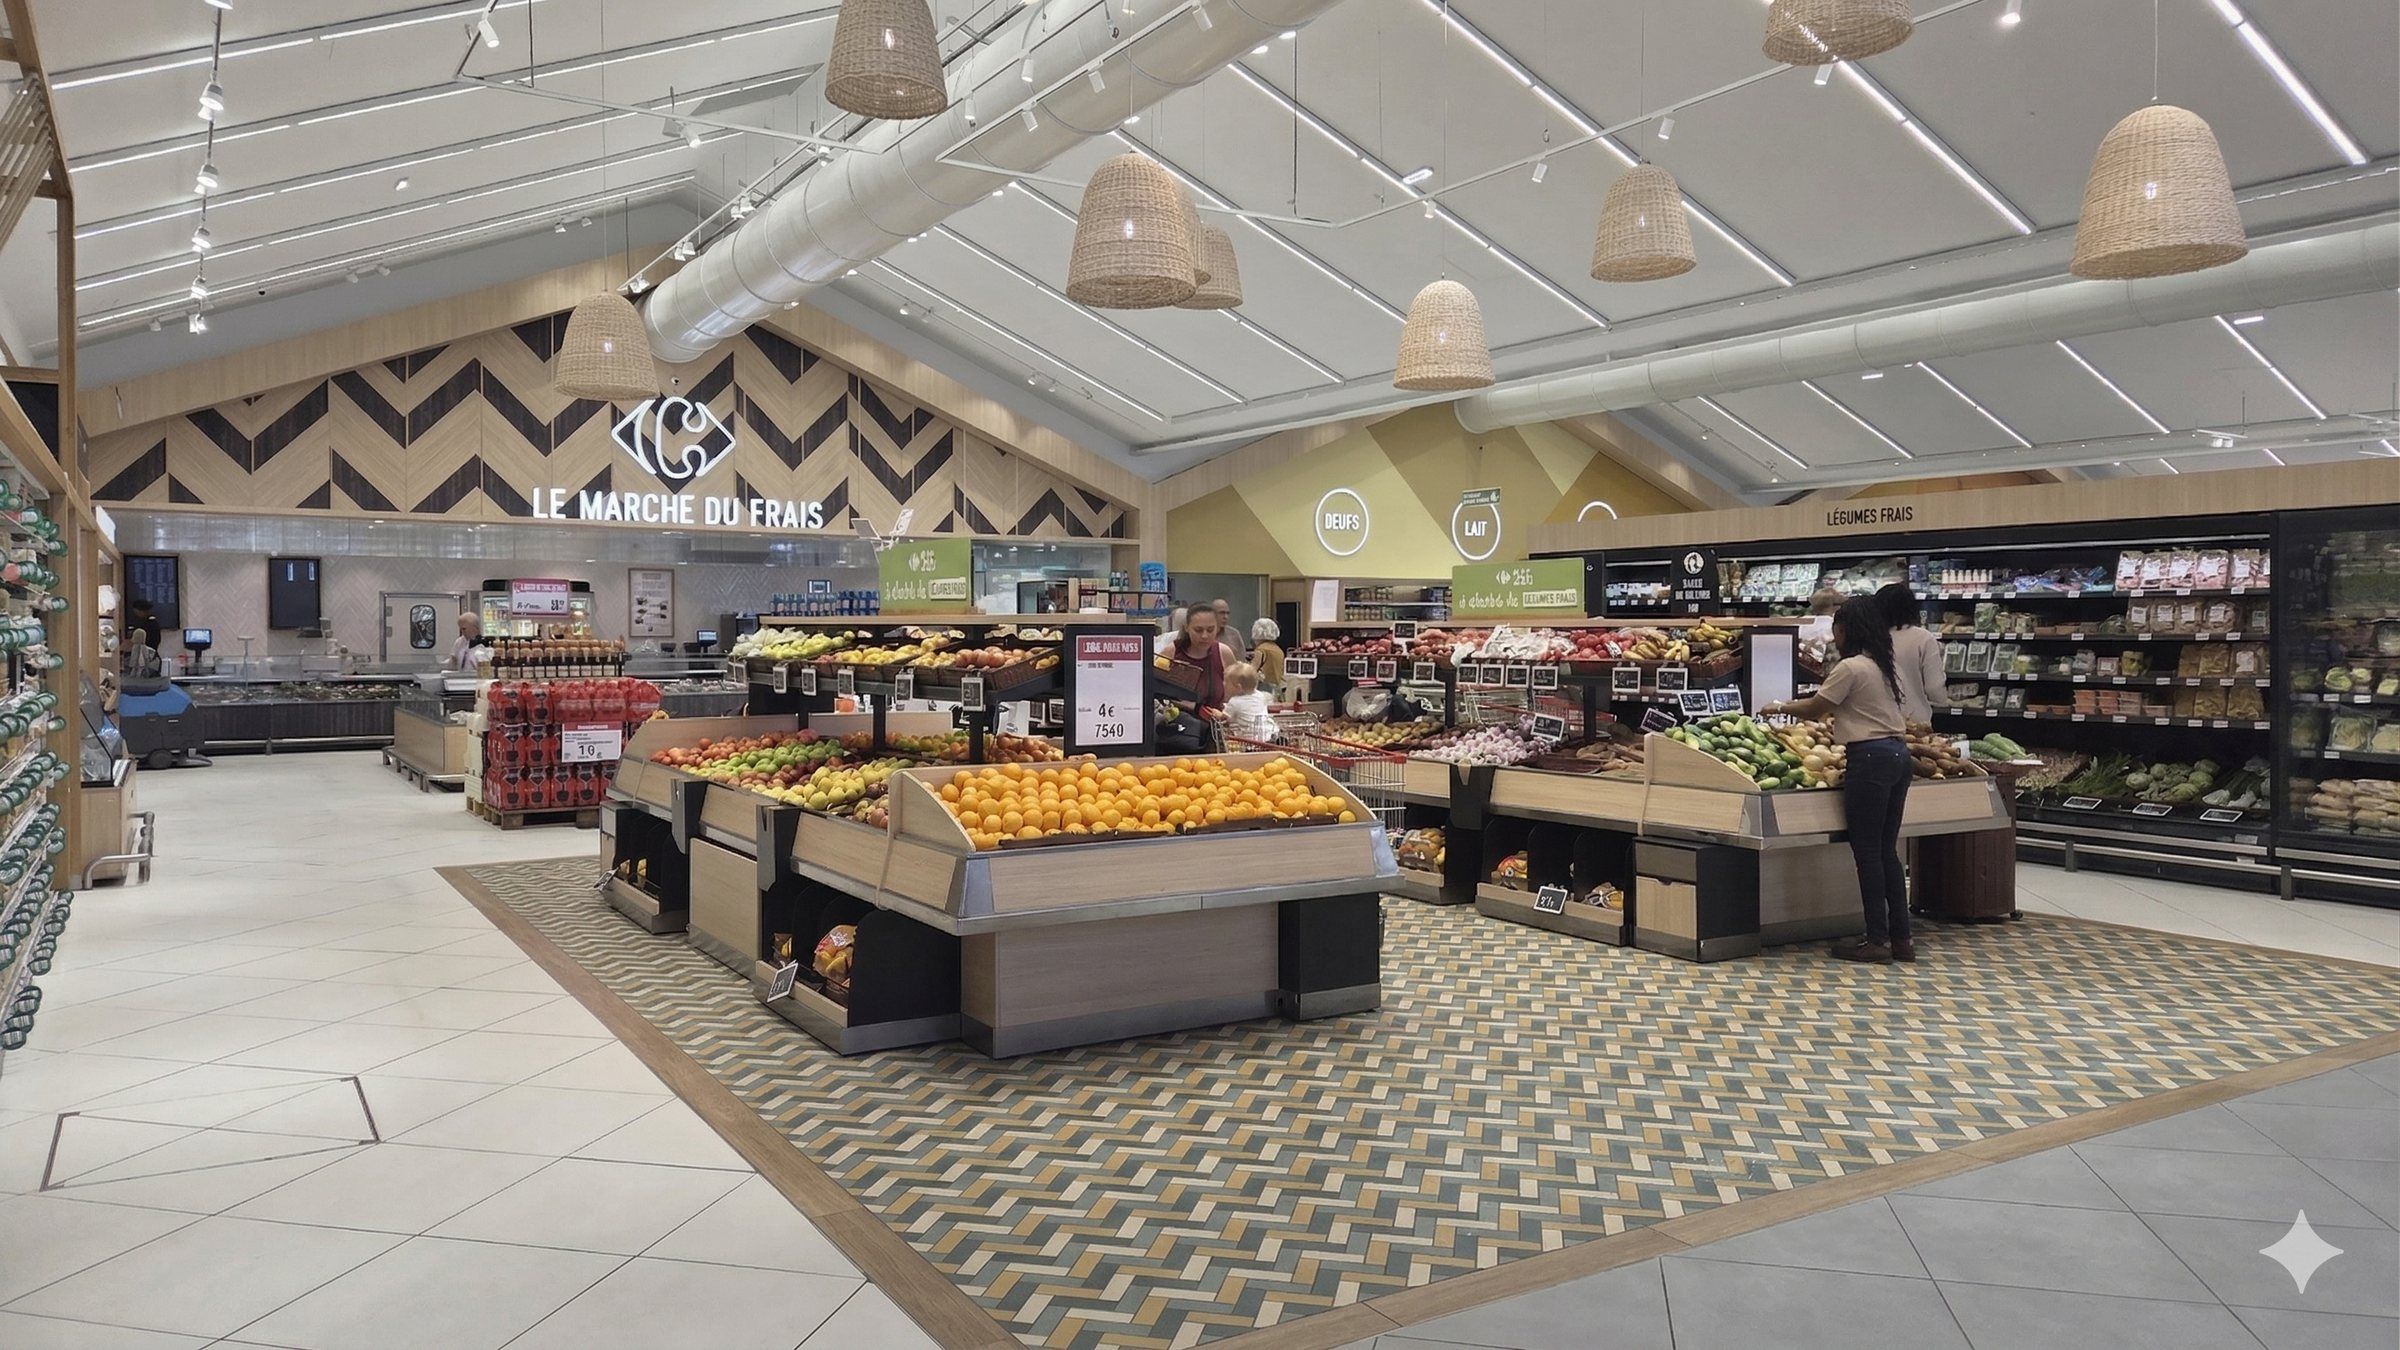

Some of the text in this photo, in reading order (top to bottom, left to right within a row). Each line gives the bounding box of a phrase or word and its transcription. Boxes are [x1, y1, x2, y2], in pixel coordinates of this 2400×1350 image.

[533, 487, 824, 529] LE MARCHE DU FRAIS
[1881, 506, 1913, 523] FRAIS
[1464, 520, 1488, 536] LAIT
[1095, 723, 1124, 738] 7540
